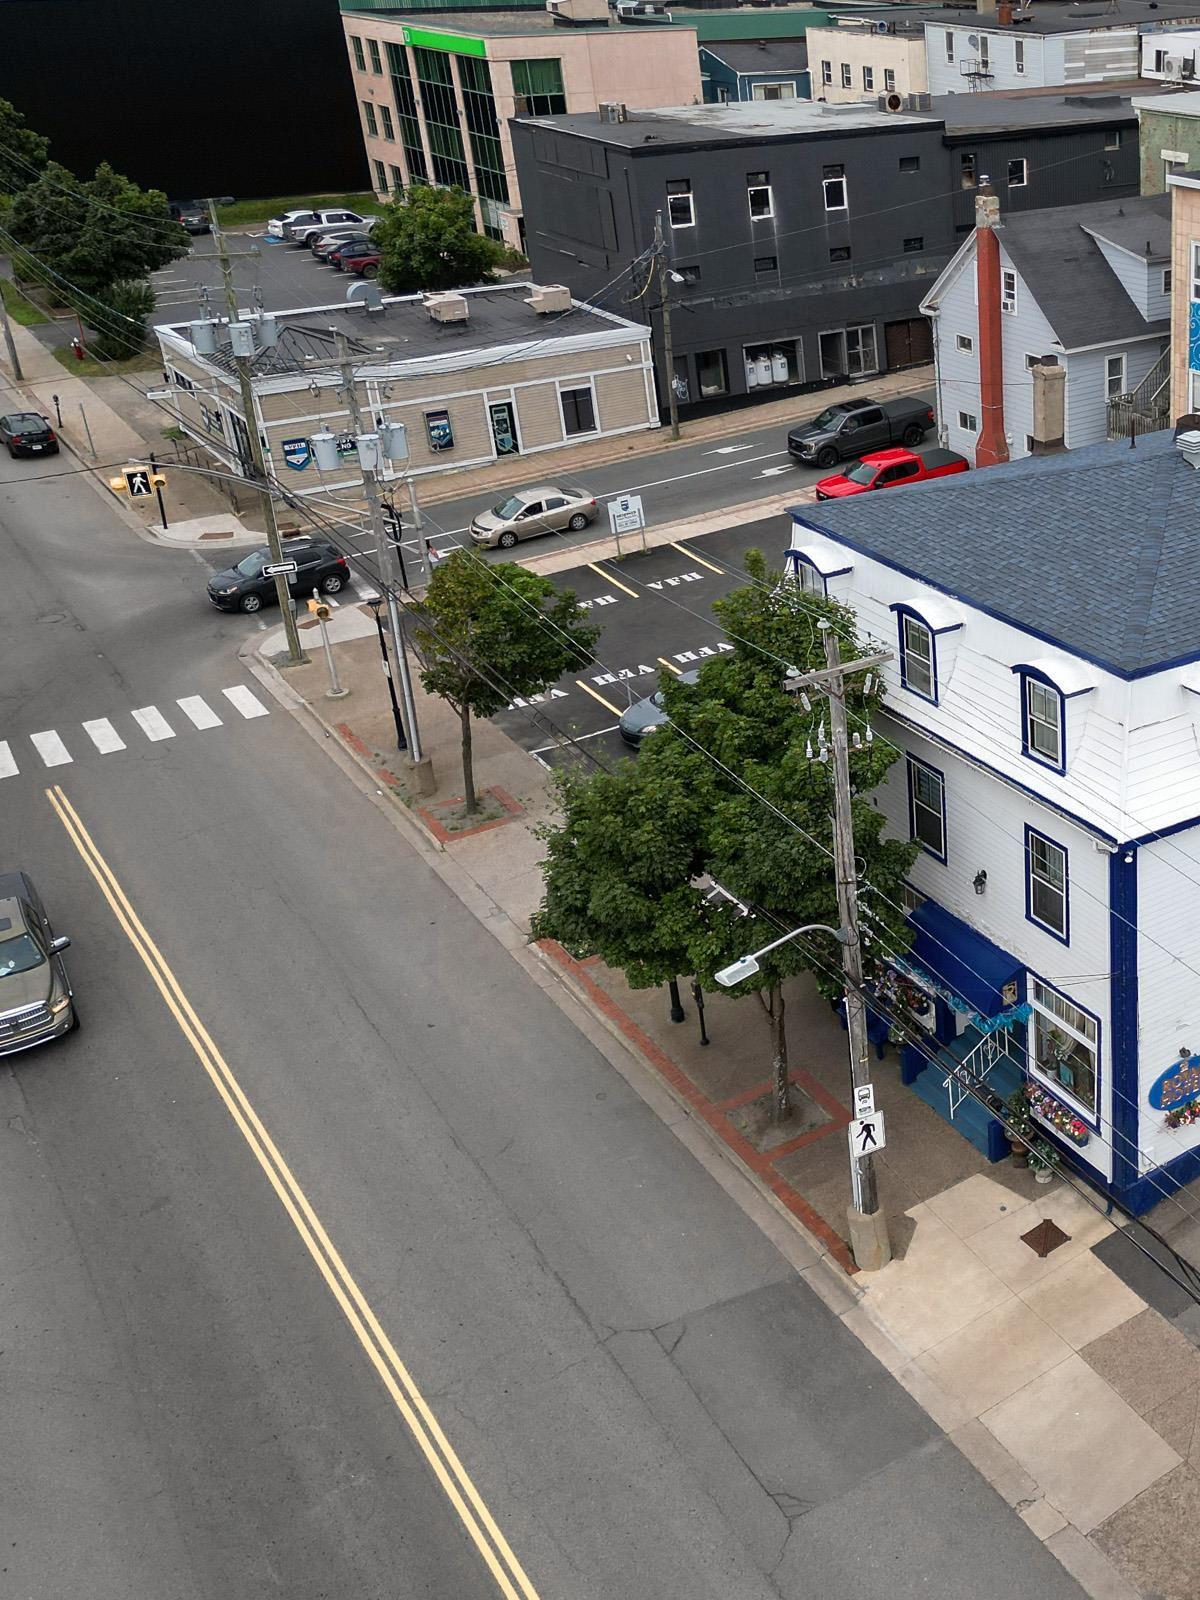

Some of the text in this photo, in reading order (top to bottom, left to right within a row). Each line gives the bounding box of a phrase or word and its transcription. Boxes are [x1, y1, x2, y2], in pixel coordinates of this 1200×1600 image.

[646, 571, 705, 590] VFH
[569, 595, 619, 611] FH
[672, 642, 735, 663] VFH
[591, 664, 656, 686] VFH
